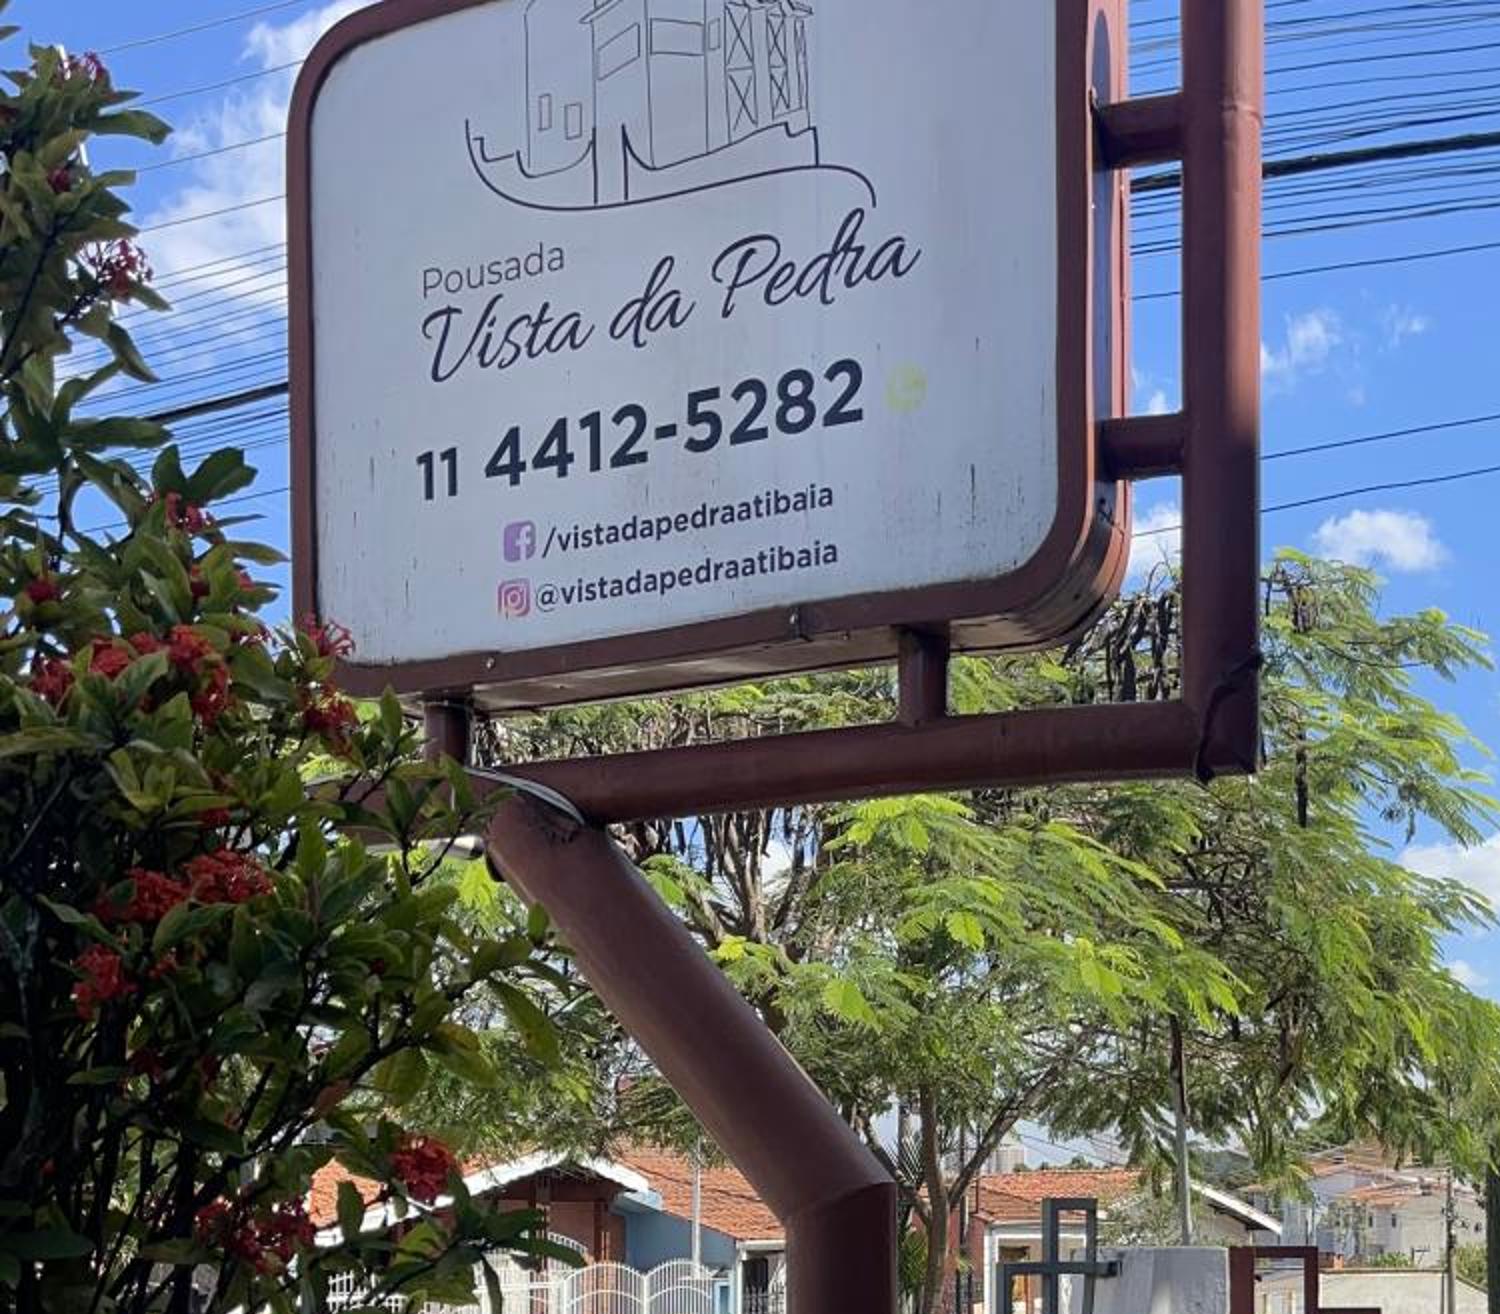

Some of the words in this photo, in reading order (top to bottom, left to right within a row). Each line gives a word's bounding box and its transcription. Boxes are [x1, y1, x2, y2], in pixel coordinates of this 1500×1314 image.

[421, 293, 596, 383] Vista
[608, 255, 697, 349] da
[711, 207, 922, 319] Pedra
[422, 241, 565, 299] Pousada
[415, 446, 460, 501] 11
[483, 357, 864, 488] 4412-5282
[541, 484, 835, 559] /vistadapedraatibaia
[535, 539, 839, 613] @vistadapedraatibaia
